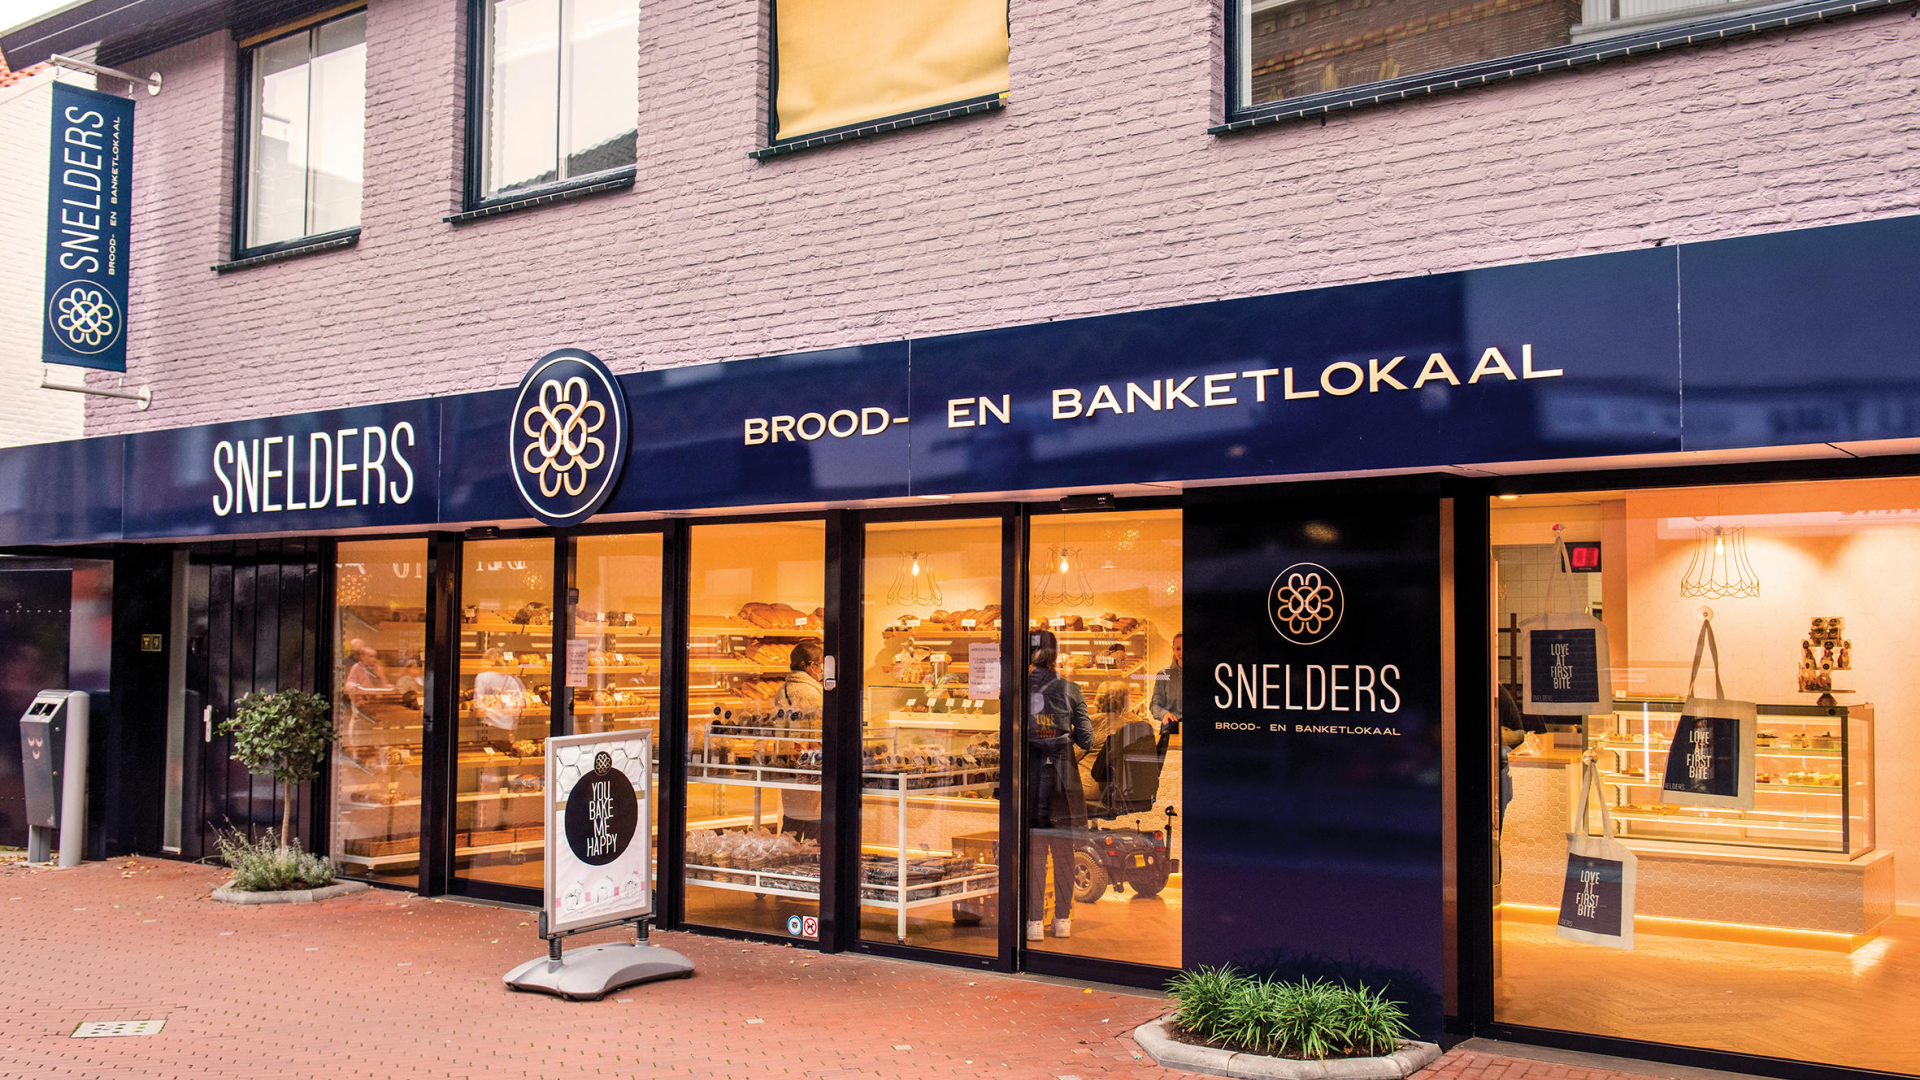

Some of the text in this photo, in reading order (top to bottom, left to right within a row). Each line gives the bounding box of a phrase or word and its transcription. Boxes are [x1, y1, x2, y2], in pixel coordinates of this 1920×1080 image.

[59, 106, 104, 273] SNELDERS
[108, 116, 120, 275] BROOD- EN BANKETLOKAAL
[744, 343, 1564, 446] BROOD- EN BANKETLOKAAL
[212, 421, 415, 517] SNELDERS
[1572, 547, 1599, 567] 01
[1551, 643, 1569, 656] LOVE
[1556, 654, 1565, 667] AT
[1550, 665, 1573, 679] FIRST
[1214, 662, 1401, 714] SNELDERS
[1553, 677, 1571, 689] BITE
[1215, 722, 1401, 736] BROOD- EN BANKETLOKAAL
[1689, 730, 1710, 744] LOVE
[1694, 742, 1705, 755] AT
[1686, 753, 1711, 768] FIRST
[1689, 765, 1708, 779] BITE
[592, 780, 611, 801] YOU
[589, 798, 614, 821] BAKE
[593, 817, 610, 837] ME
[586, 833, 618, 857] HAPPY
[1580, 870, 1600, 885] LOVE
[1583, 882, 1595, 894] AT
[1575, 892, 1599, 907] FIRST
[1577, 903, 1596, 919] BITE
